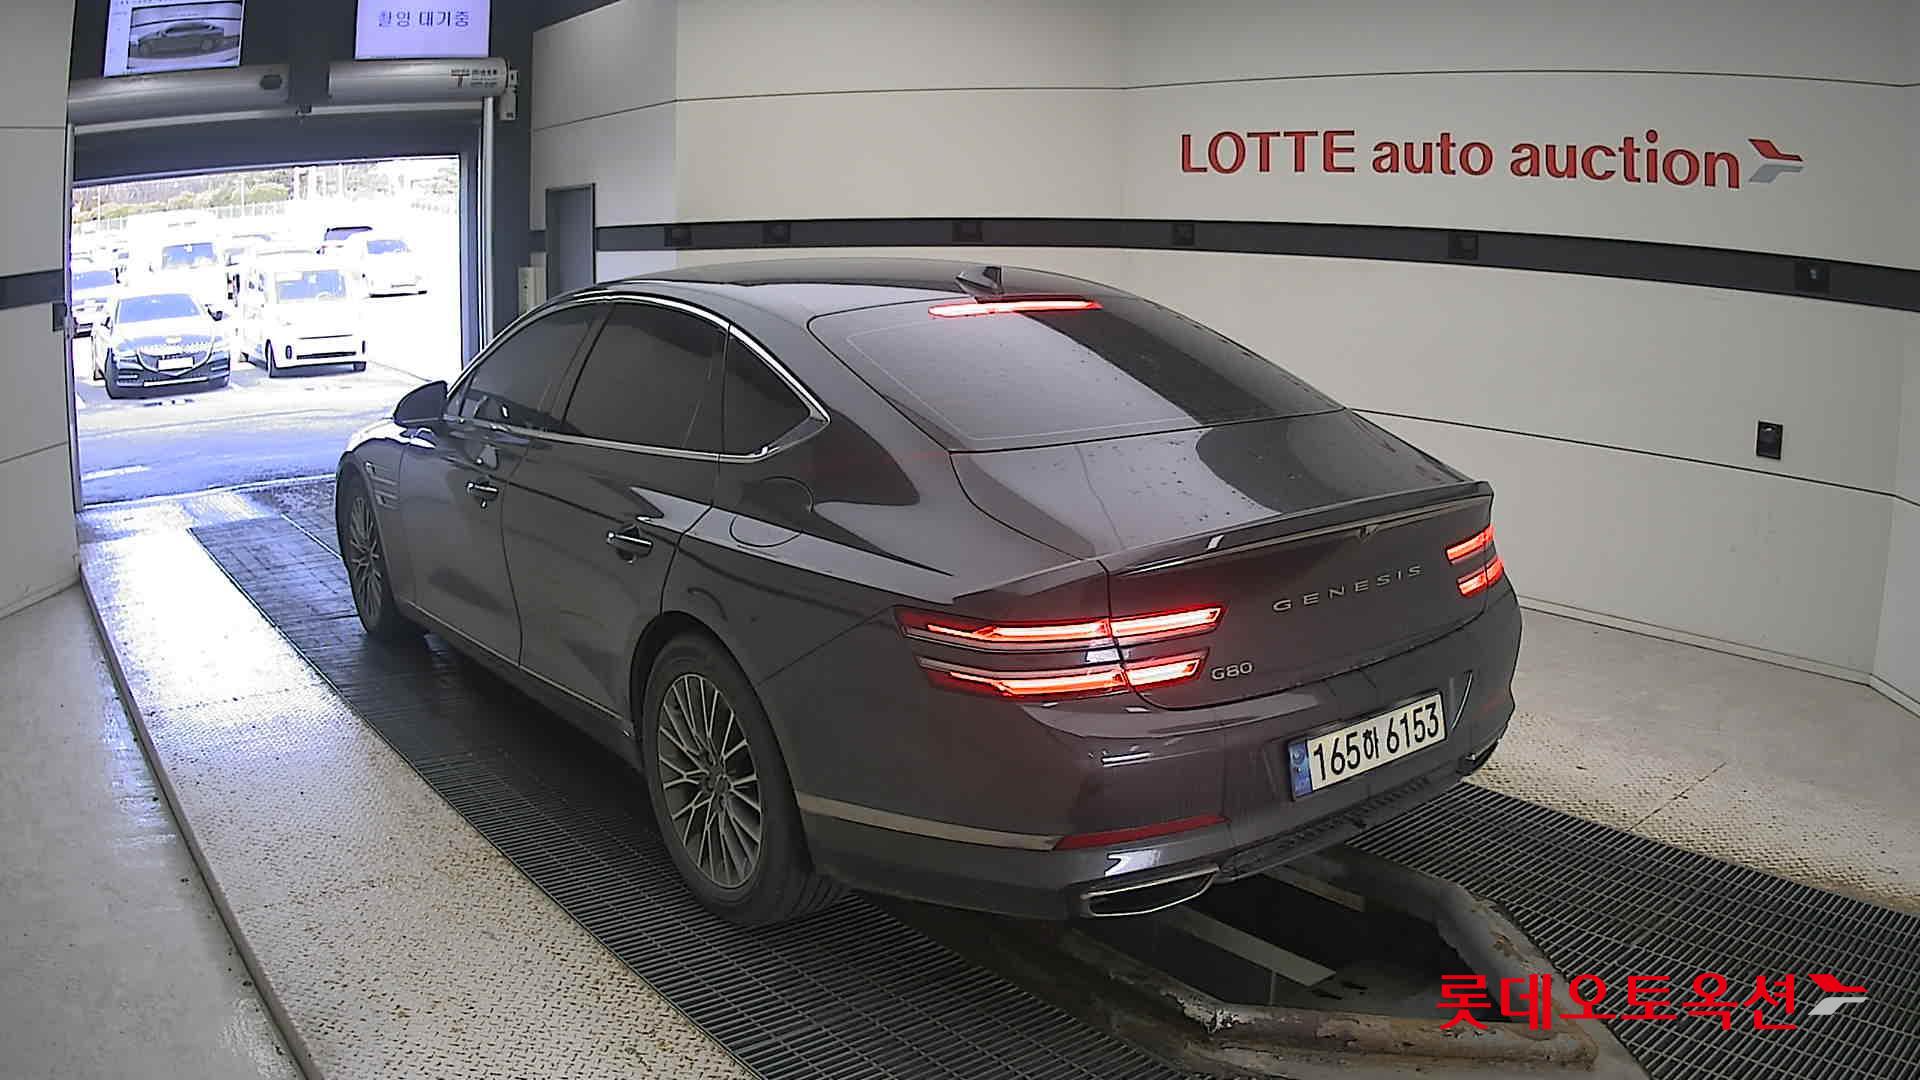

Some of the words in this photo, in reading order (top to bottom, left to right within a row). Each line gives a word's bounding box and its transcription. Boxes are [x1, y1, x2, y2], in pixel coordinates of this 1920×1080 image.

[419, 10, 470, 27] 대기중
[1181, 130, 1356, 173] LOTTE
[1371, 132, 1494, 176] auto
[1510, 129, 1740, 189] auction
[1272, 565, 1423, 612] GENESIS
[1210, 661, 1254, 681] G80
[1313, 726, 1380, 781] 165하
[1386, 702, 1440, 755] 6153
